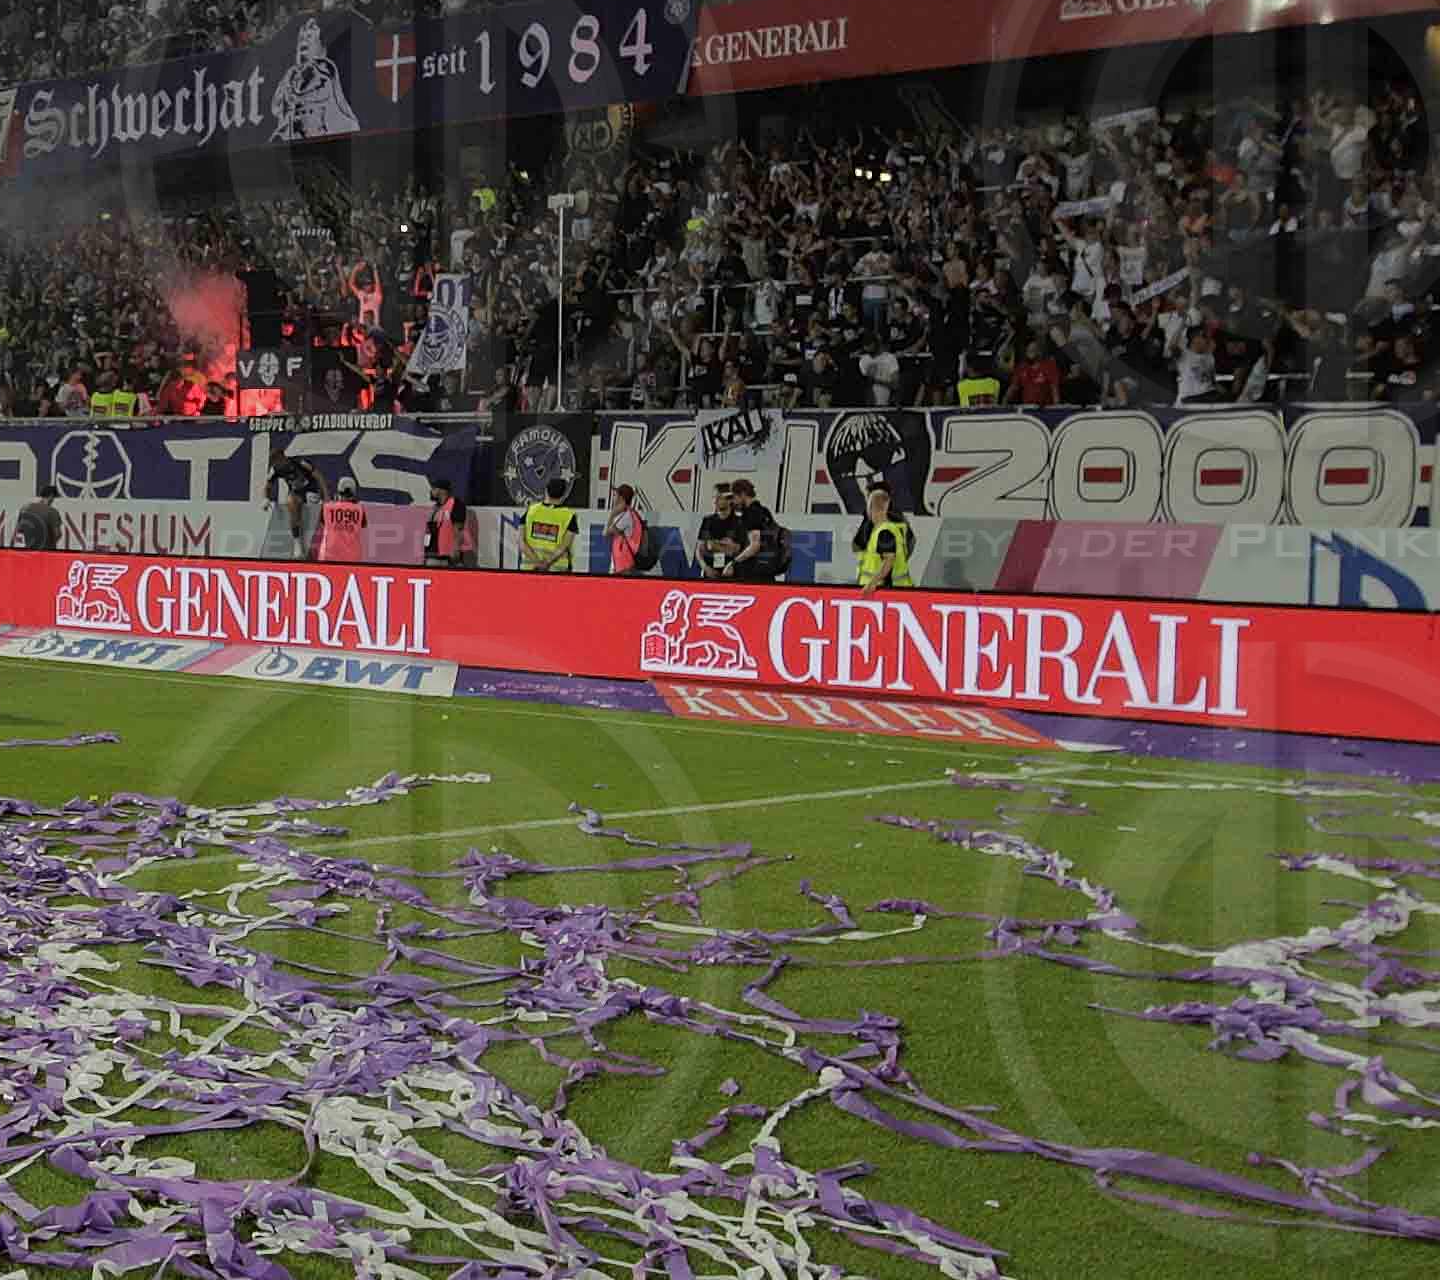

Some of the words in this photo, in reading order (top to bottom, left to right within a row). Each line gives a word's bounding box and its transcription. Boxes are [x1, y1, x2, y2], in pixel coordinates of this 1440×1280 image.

[421, 52, 467, 82] seit
[471, 6, 653, 95] 1984
[704, 17, 848, 65] GENERALI
[23, 63, 264, 160] Schwechat
[937, 408, 1422, 526] 2000
[136, 564, 432, 654] GENERALI
[298, 656, 433, 690] BWT
[767, 596, 1250, 718] GENERALI
[672, 685, 1042, 744] KURIER
